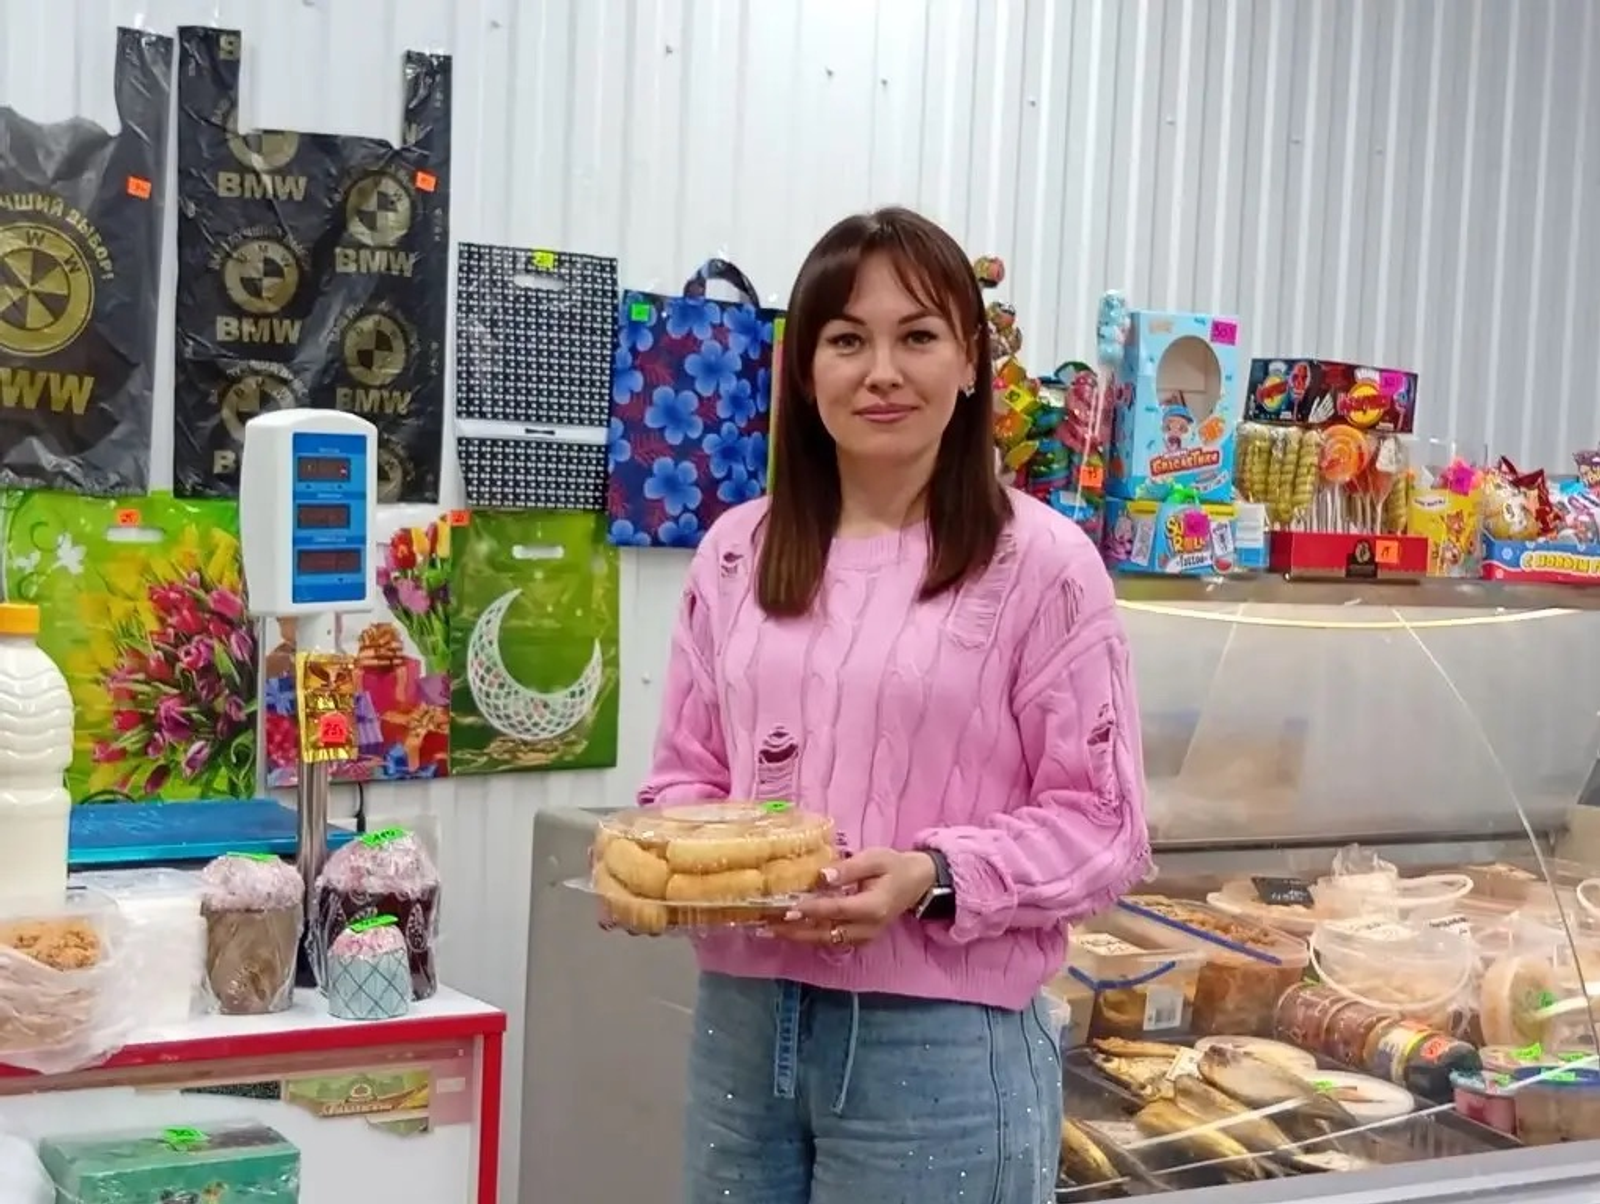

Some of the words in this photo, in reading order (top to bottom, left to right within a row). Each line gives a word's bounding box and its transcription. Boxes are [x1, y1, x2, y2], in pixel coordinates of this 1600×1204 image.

[217, 172, 307, 201] BMW
[334, 247, 415, 277] BMW
[216, 316, 303, 344] BMW
[336, 387, 412, 415] BMW
